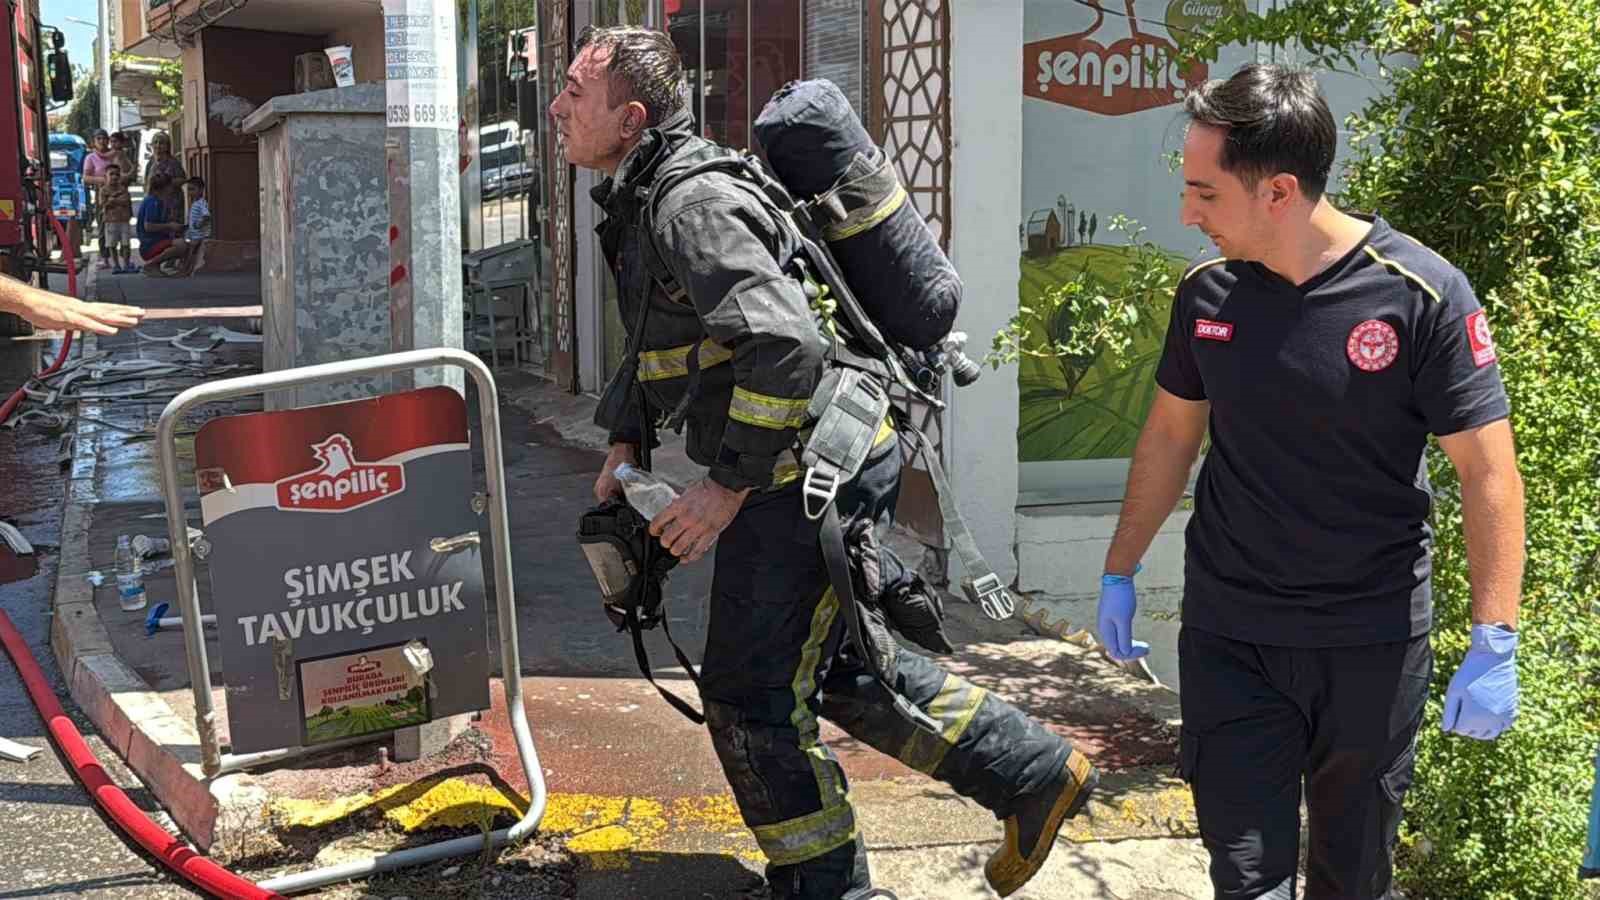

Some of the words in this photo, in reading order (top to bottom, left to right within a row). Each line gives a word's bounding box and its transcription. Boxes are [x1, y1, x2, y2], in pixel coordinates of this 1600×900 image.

[1182, 0, 1223, 17] Güven
[387, 104, 410, 123] 0539
[414, 104, 437, 123] 669
[291, 471, 389, 503] şenpiliç
[284, 551, 415, 607] ŞİMŞEK
[238, 581, 466, 647] TAVUKÇULUK
